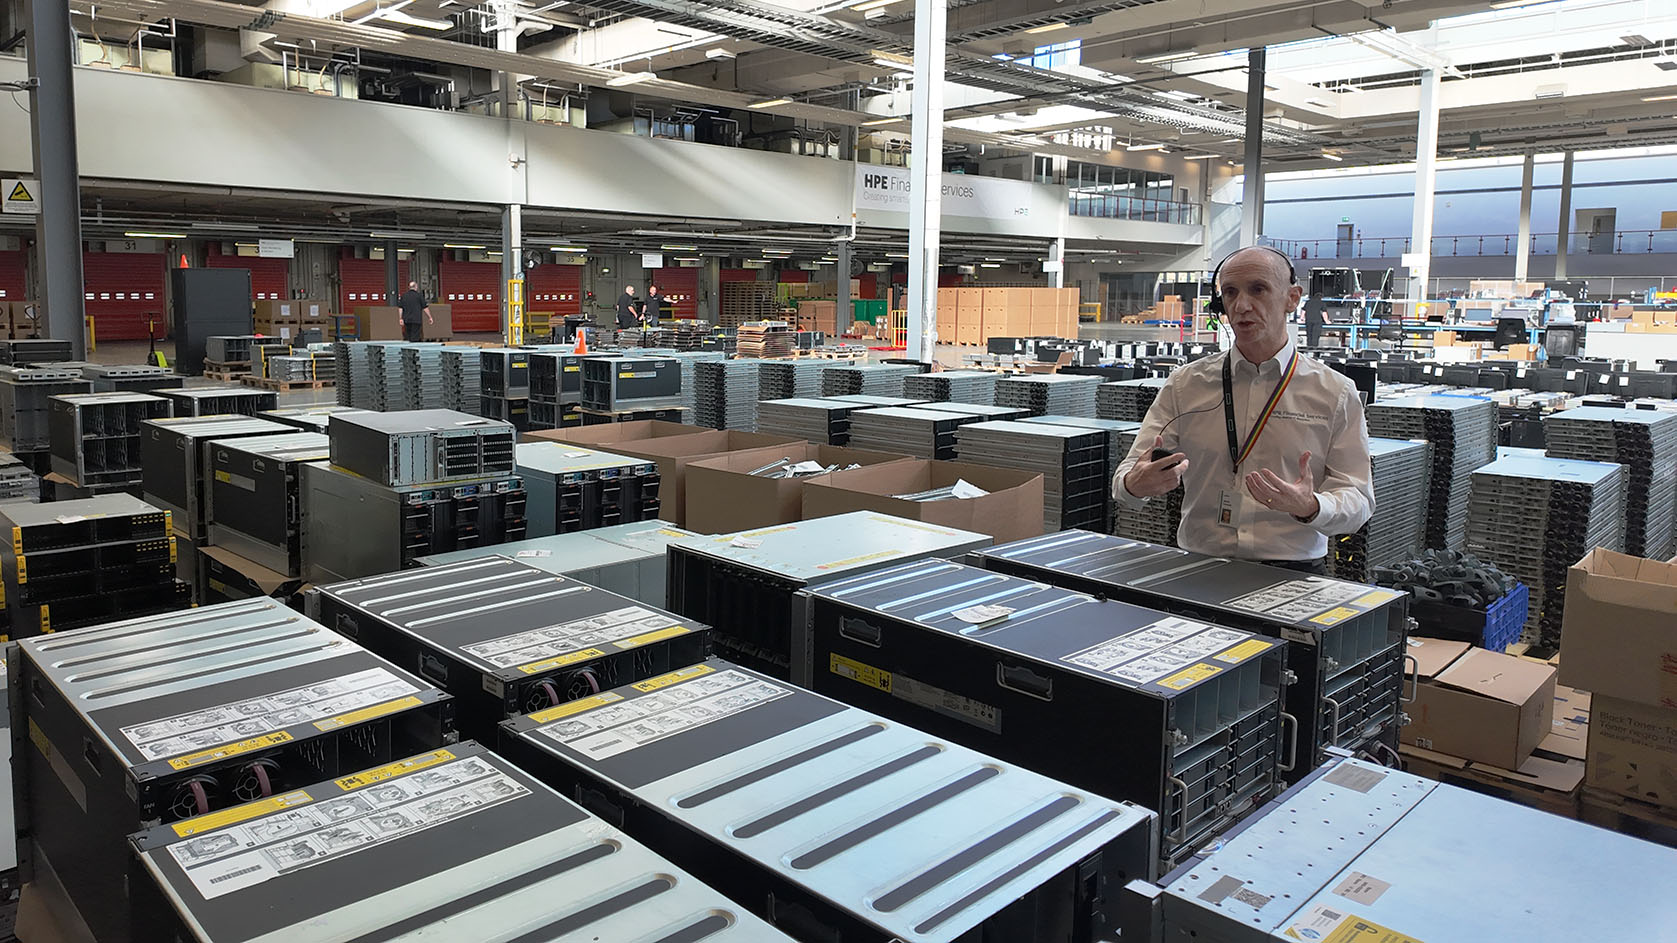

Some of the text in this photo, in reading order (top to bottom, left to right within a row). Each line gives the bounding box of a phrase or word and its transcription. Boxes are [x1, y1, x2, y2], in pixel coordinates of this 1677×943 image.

[864, 173, 974, 198] HPE Fina ervices
[124, 241, 137, 250] 31
[1600, 711, 1623, 723] Black
[1627, 716, 1656, 731] Toner
